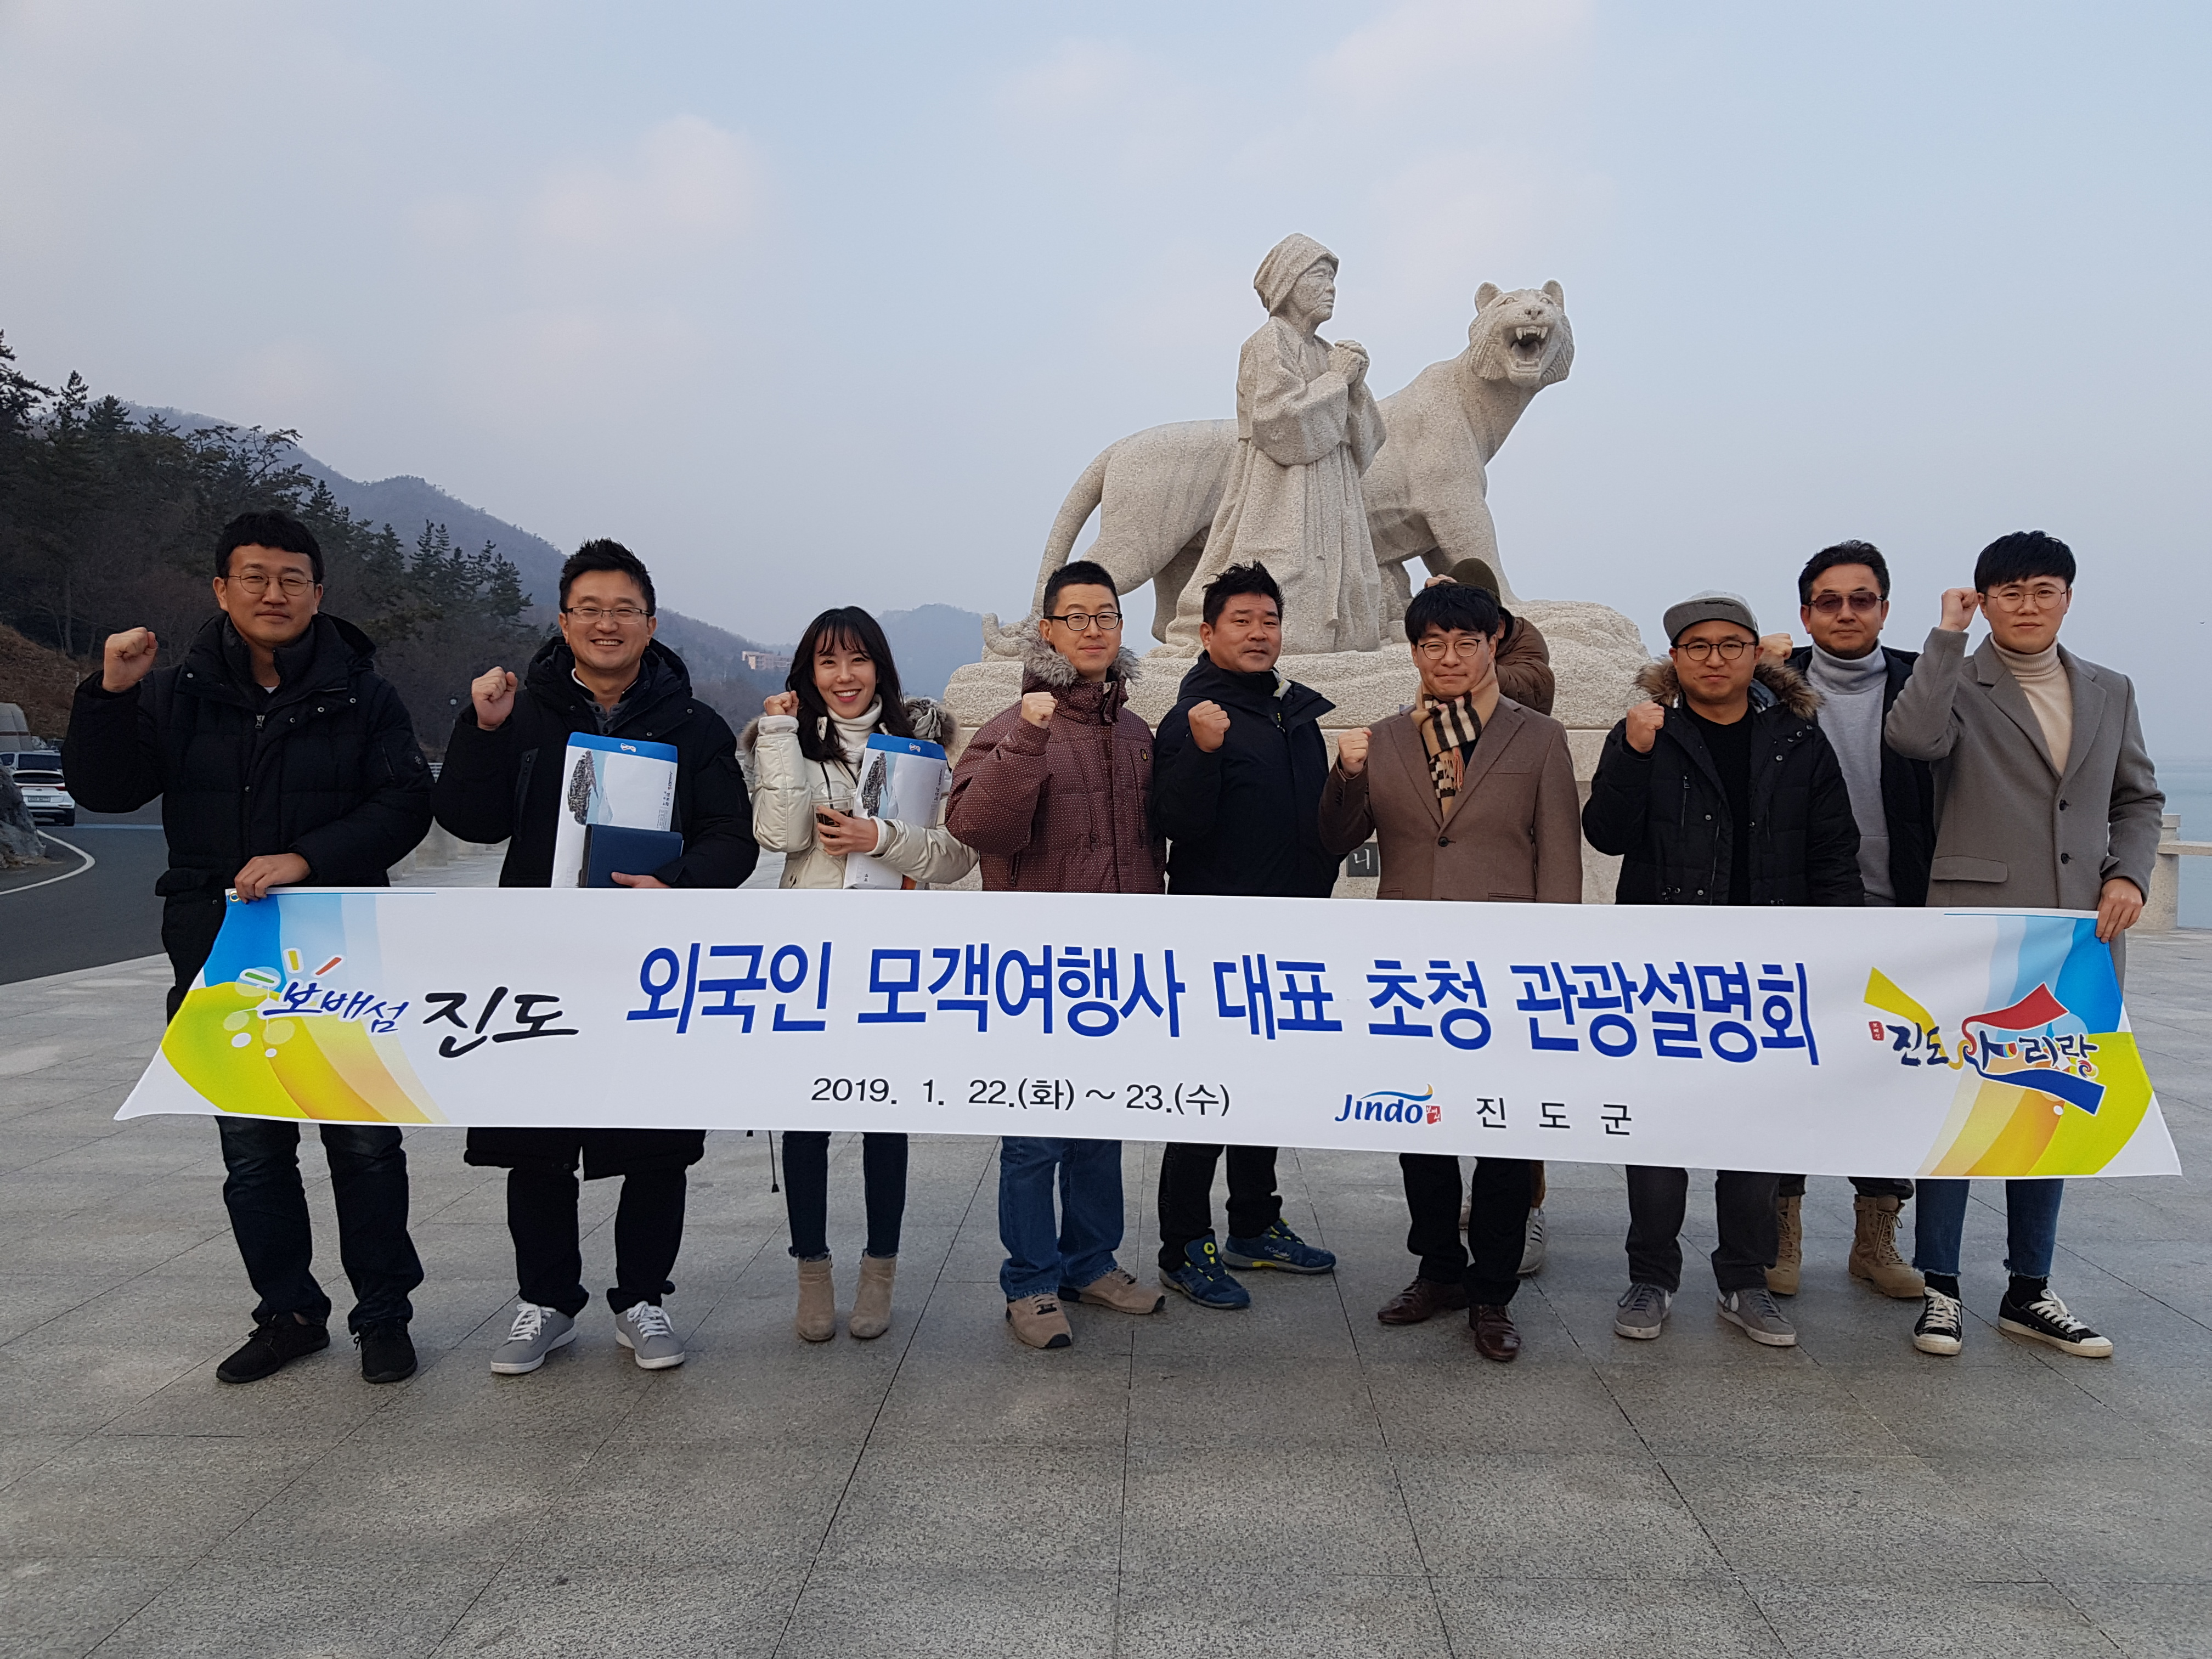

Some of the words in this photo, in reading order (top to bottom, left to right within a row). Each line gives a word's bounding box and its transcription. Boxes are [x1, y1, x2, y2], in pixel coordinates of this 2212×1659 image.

[262, 980, 409, 1033] 보배섬
[423, 987, 579, 1058] 진도
[627, 941, 832, 1034] 외국인
[857, 943, 1186, 1037] 모객여행사
[1214, 953, 1343, 1040] 대표
[1366, 960, 1492, 1050] 초청
[1510, 961, 1819, 1065] 관광설명회
[1886, 1022, 1950, 1067] 진도
[811, 1078, 897, 1104] 2019.
[923, 1079, 944, 1105] 1.
[1335, 1094, 1423, 1124] Jindo
